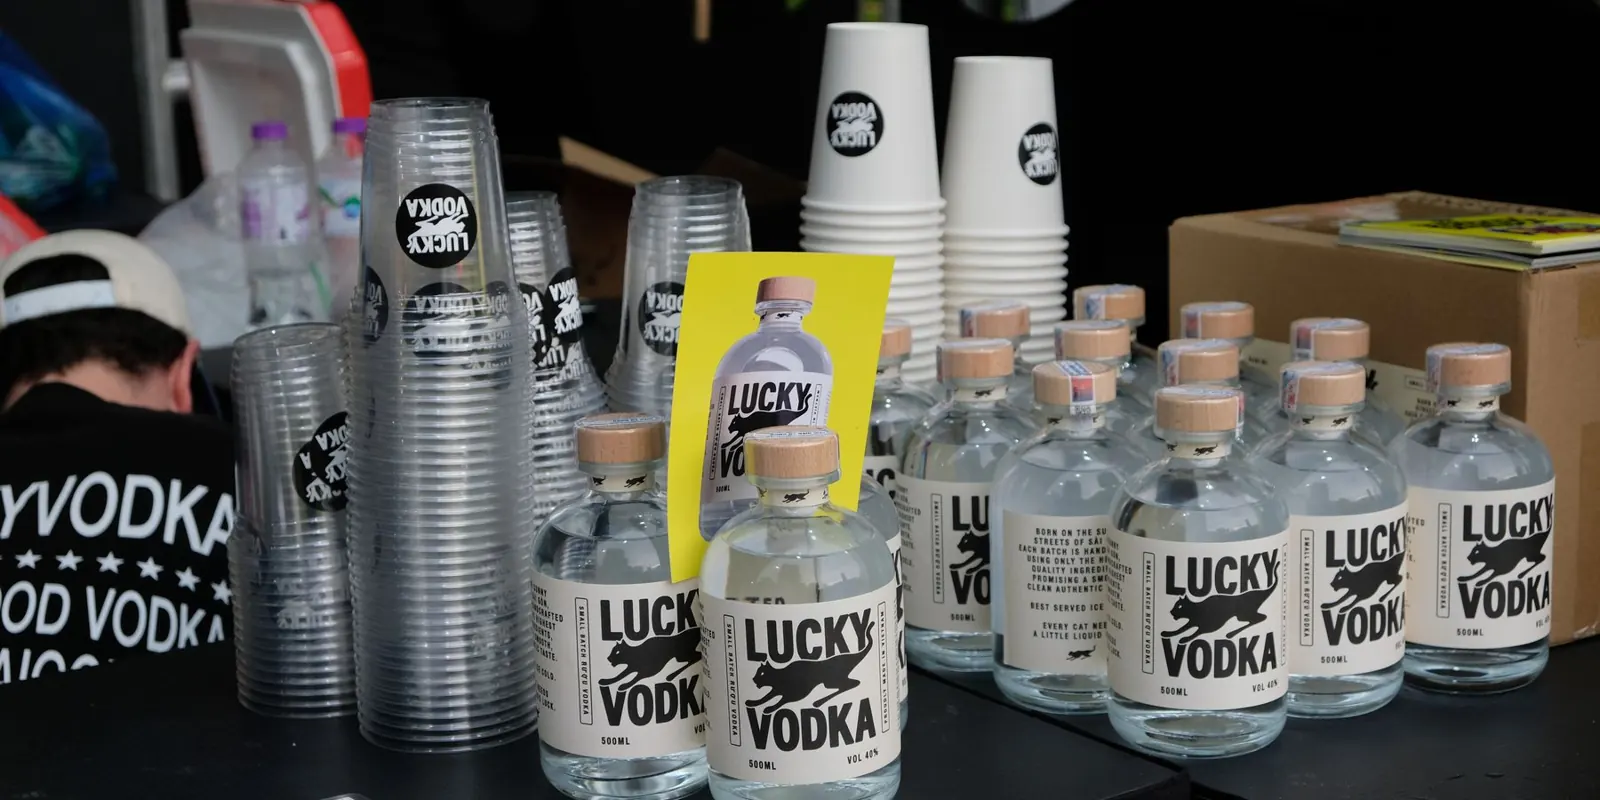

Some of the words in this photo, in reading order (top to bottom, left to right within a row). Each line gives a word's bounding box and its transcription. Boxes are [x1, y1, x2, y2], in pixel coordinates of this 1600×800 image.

[831, 102, 877, 119] VODKA
[831, 130, 876, 148] LUCKY
[406, 196, 469, 218] VODKA
[409, 232, 469, 254] LUCKY
[648, 291, 684, 311] ODKA
[645, 322, 680, 342] CKY
[728, 381, 812, 415] LUCKY
[1463, 493, 1553, 542] LUCKY
[1034, 537, 1070, 546] STREETS
[1074, 538, 1084, 546] OF
[1036, 527, 1057, 536] BORN
[1061, 529, 1073, 537] ON
[1076, 528, 1092, 536] THE
[1018, 544, 1037, 553] EACH
[1041, 547, 1067, 555] BATCH
[1027, 555, 1051, 564] USING
[1054, 557, 1075, 565] ONLY
[1080, 557, 1095, 565] THE
[1032, 565, 1066, 574] QUALITY
[1032, 574, 1079, 584] PROMISING
[1166, 548, 1278, 597] LUCKY
[1027, 583, 1052, 592] CLEAN
[1056, 584, 1103, 593] AUTHENTIC
[1458, 571, 1549, 618] VODKA
[0, 580, 71, 635] OD
[600, 588, 699, 641] LUCK
[1030, 602, 1050, 611] BEST
[1053, 603, 1086, 612] SERVED
[1090, 602, 1104, 611] ICE
[745, 608, 871, 663] LUCKY
[1041, 631, 1069, 640] LITTLE
[1073, 631, 1102, 640] LIQUID
[1042, 621, 1068, 630] EVERY
[1072, 622, 1088, 630] CAT
[1092, 621, 1107, 630] NEE
[1457, 628, 1484, 636] 500ML
[1144, 639, 1152, 664] VODKA
[1161, 631, 1277, 679] VODKA
[1320, 656, 1348, 664] 500ML
[1160, 686, 1188, 696] 500ML
[1252, 683, 1265, 692] VOL
[600, 675, 705, 727] VODK
[731, 708, 739, 736] VODKA
[746, 697, 876, 752] VODKA
[601, 737, 630, 745] 500ML
[749, 759, 776, 770] 500ML
[847, 754, 862, 765] VOL
[865, 748, 879, 760] 40%
